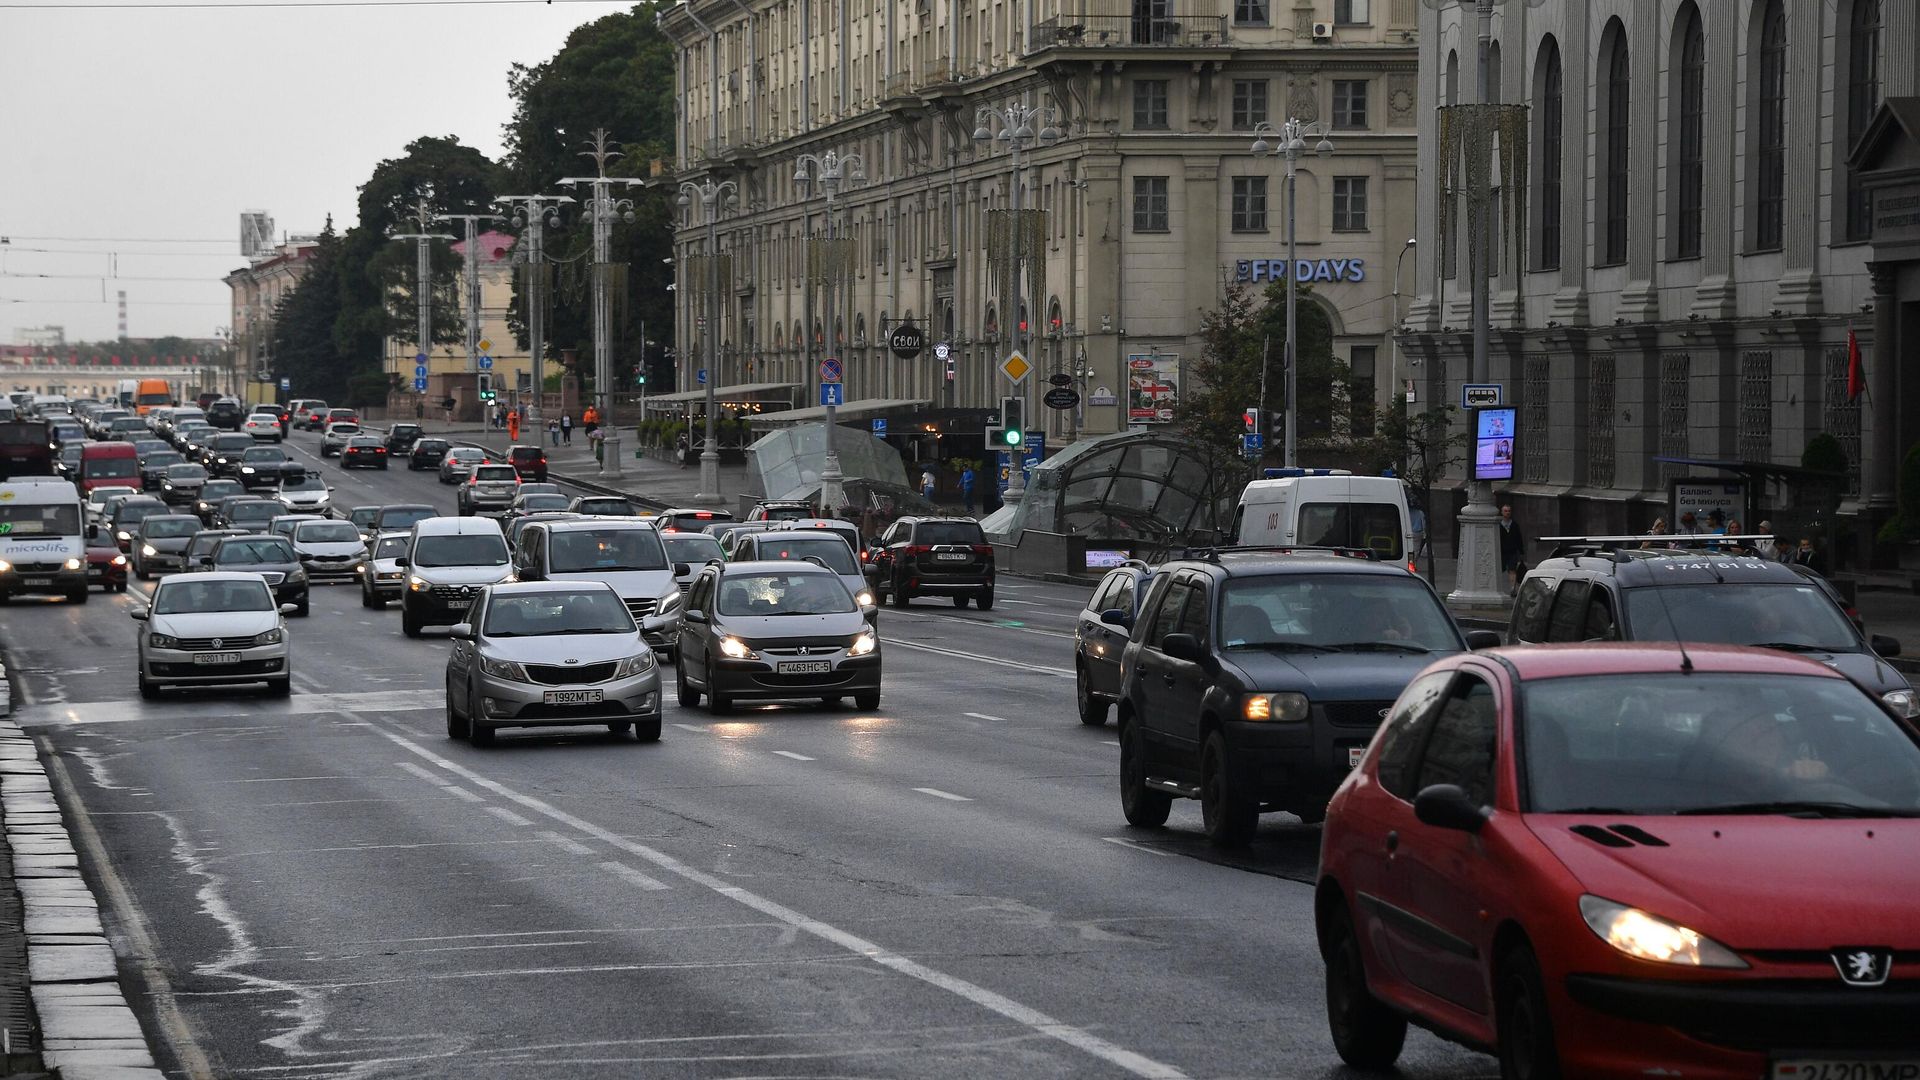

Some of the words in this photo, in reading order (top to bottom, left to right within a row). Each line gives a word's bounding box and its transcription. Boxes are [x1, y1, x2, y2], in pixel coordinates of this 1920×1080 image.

[1251, 259, 1365, 283] FRDAYS
[893, 335, 920, 347] СВОИ
[1099, 388, 1104, 396] 7
[1680, 487, 1712, 496] Баланс
[1680, 497, 1696, 505] без
[1267, 512, 1279, 531] 103
[6, 543, 70, 554] microlife
[786, 662, 829, 672] 4463HC-5
[554, 691, 601, 703] 1992MT-5
